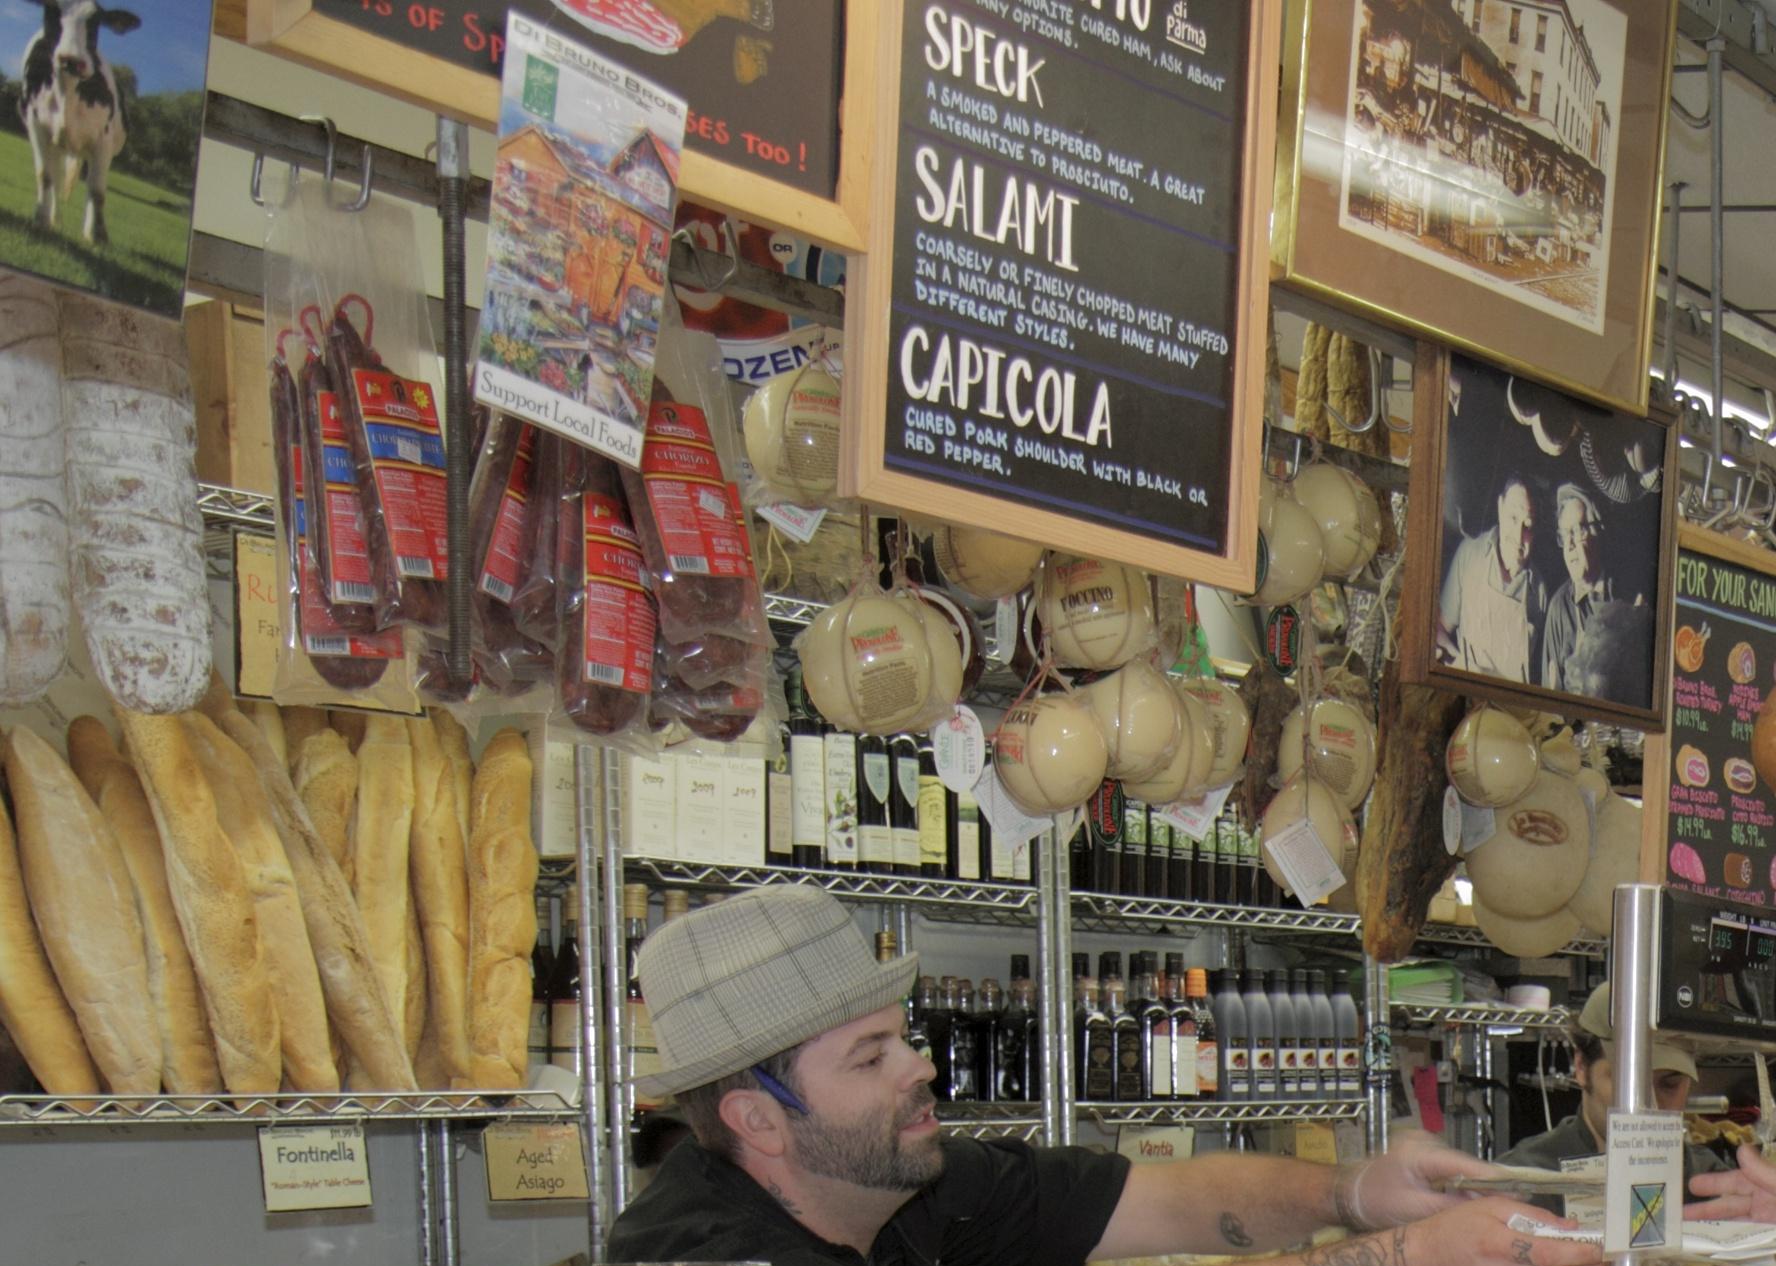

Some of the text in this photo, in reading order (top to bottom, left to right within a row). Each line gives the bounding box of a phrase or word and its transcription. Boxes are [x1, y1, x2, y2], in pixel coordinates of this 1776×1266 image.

[408, 9, 444, 32] OF
[1014, 7, 1079, 49] OPTIONS.
[924, 6, 1046, 109] SPECK
[926, 81, 1205, 205] A SMOKED AND PEPPERED MEAT. A GREAT
[929, 108, 1134, 204] ALTERNATIVE TO PROSCIUTTO.
[915, 147, 1080, 272] SALAMI
[772, 243, 792, 253] OR
[915, 280, 1075, 350] DIFFERENT STYLES.
[916, 258, 1200, 369] IN A NATURAL CASING. WE HAVE MANY
[917, 232, 1229, 356] COARSELY OR FINELY CHOPPED MEAT STUFFED
[900, 326, 1113, 449] CAPICOLA
[480, 371, 637, 459] Support Local Foods
[654, 448, 710, 465] CHORIZO
[905, 431, 1012, 477] RED PEPPER.
[905, 407, 956, 437] CURED
[1014, 438, 1087, 475] SHOULDER
[1093, 460, 1131, 487] WITH
[1136, 471, 1182, 500] BLACK
[1189, 488, 1208, 507] OR
[1677, 557, 1707, 598] FOR
[1712, 568, 1747, 608] YOUR
[642, 773, 664, 787] 2009
[691, 781, 715, 796] 2009
[733, 785, 757, 798] 2009
[277, 1142, 356, 1164] Fontinella
[516, 1148, 554, 1168] Aged
[324, 1177, 365, 1188] Table Cheese
[516, 1174, 565, 1194] Asiago
